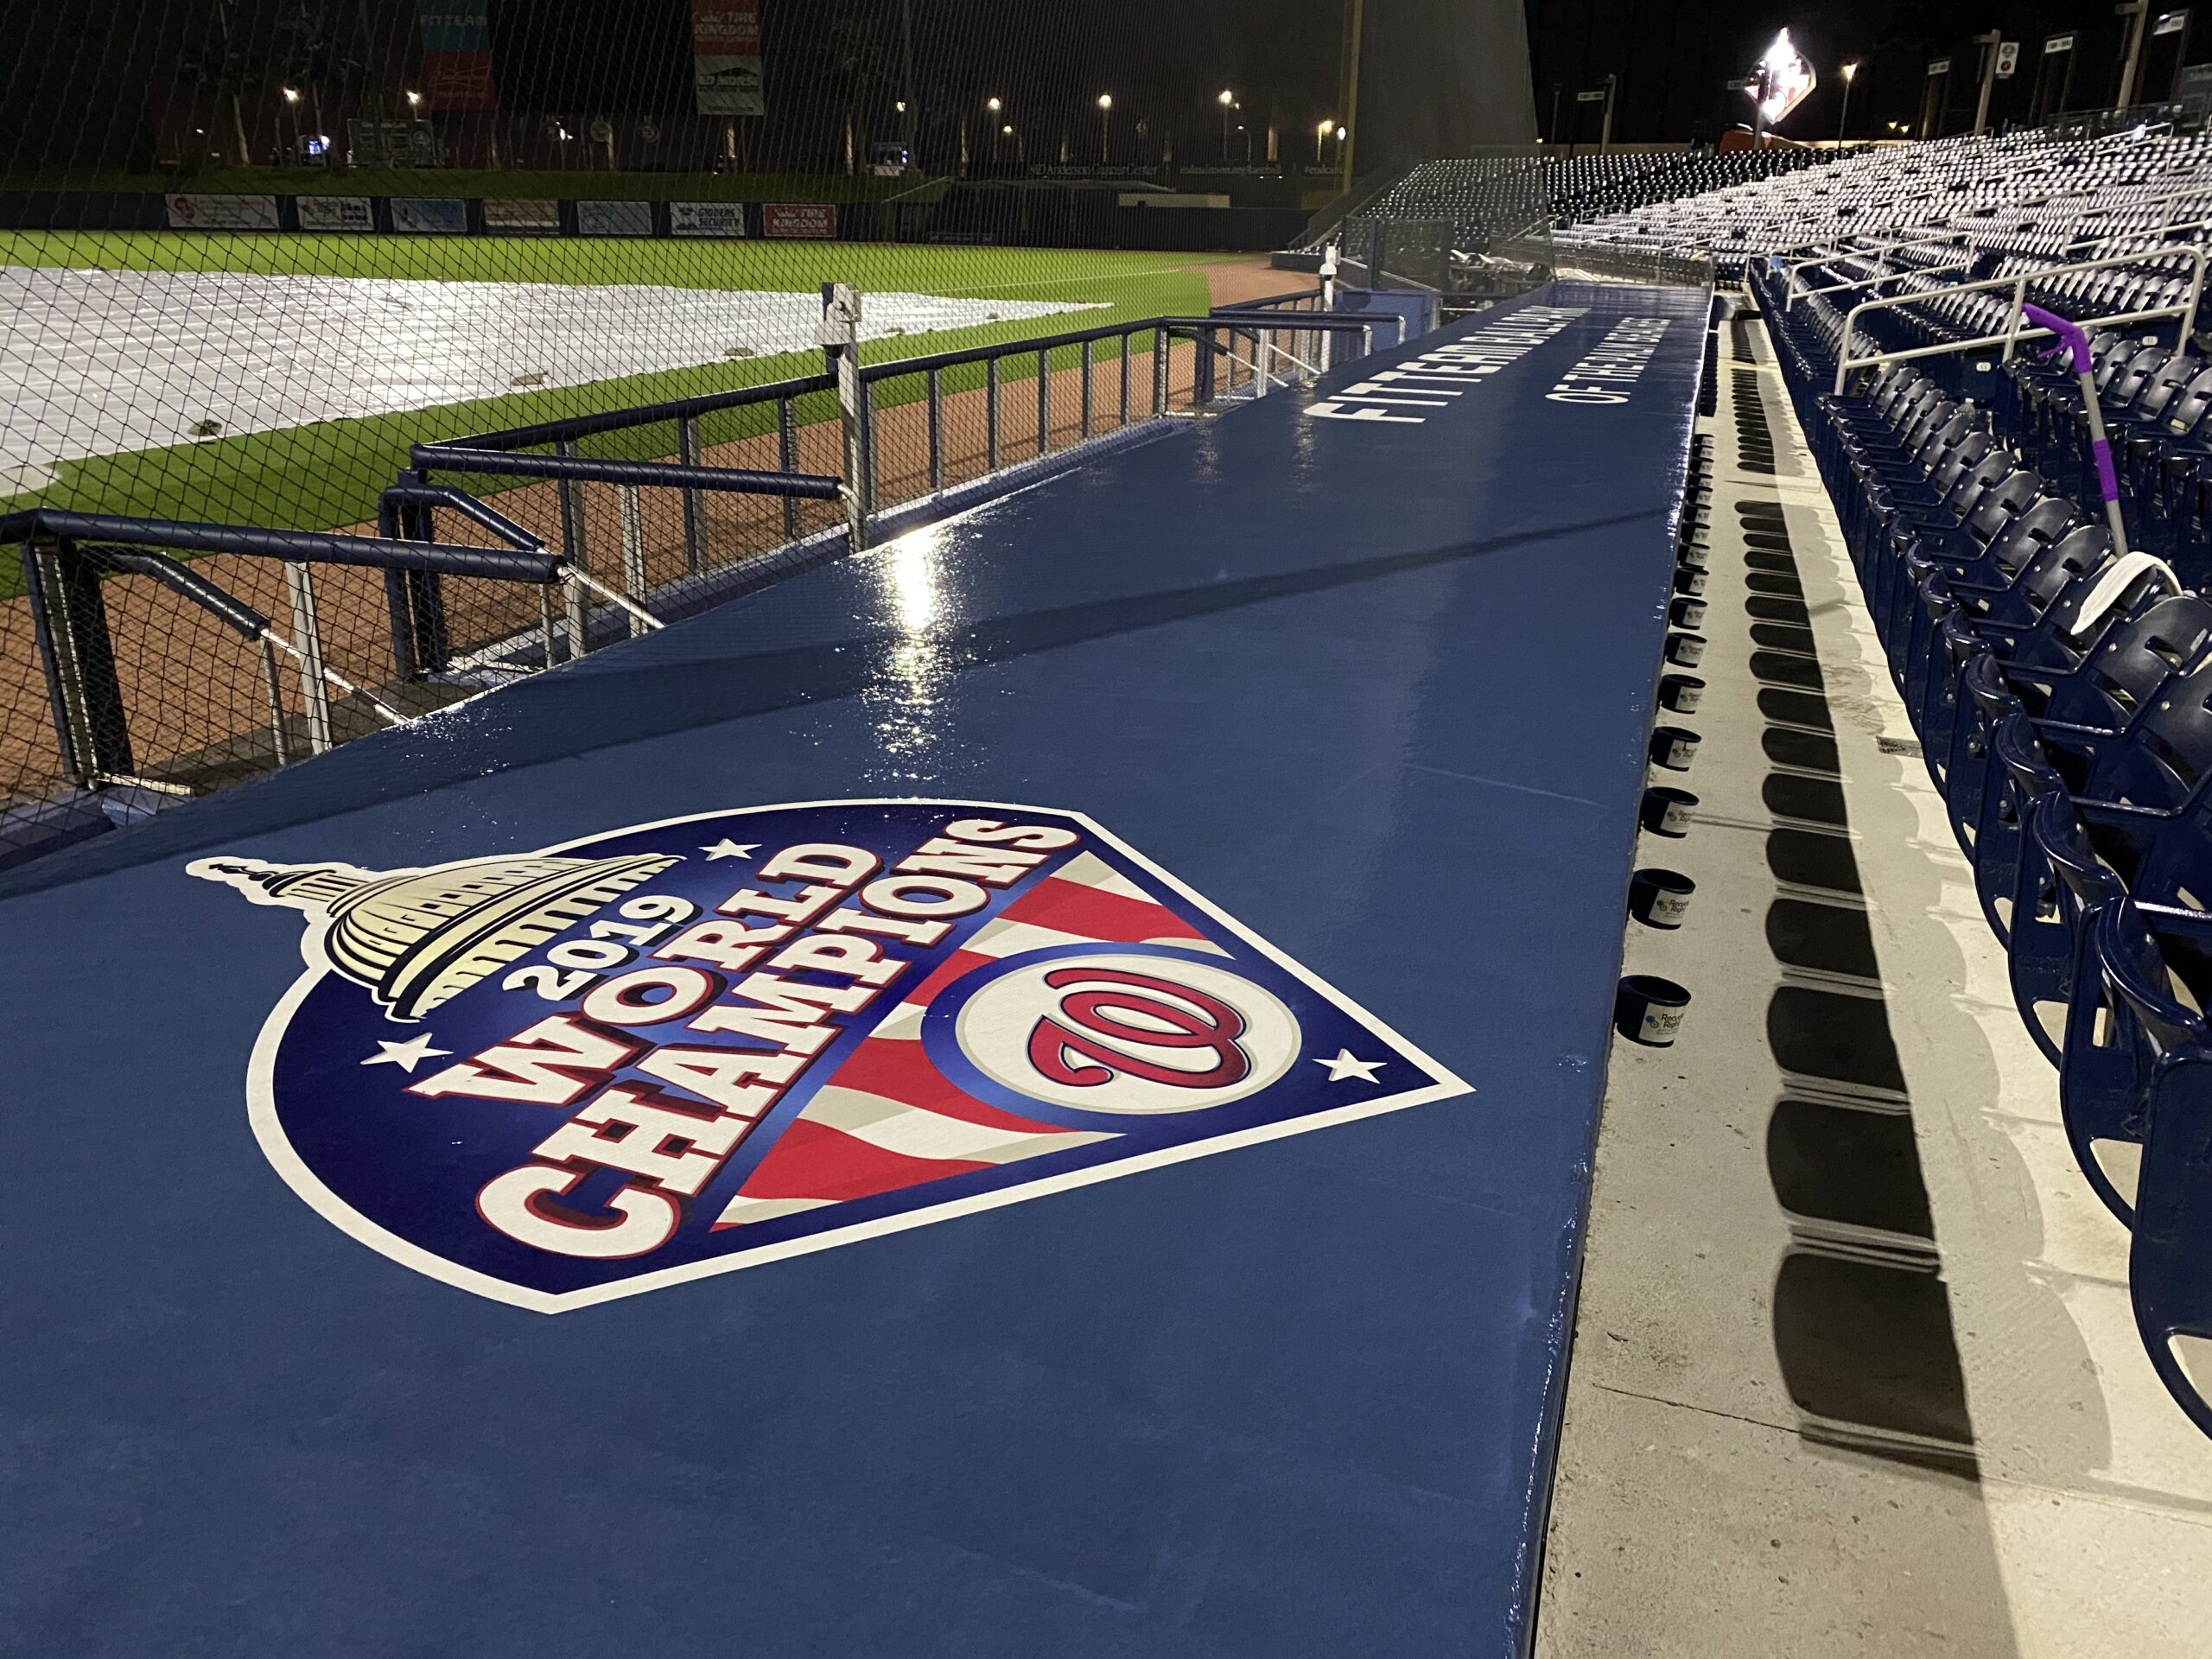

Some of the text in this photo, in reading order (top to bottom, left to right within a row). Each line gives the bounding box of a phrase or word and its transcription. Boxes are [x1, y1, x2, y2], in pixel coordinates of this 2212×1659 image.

[772, 219, 828, 228] KINGDOM
[1303, 305, 1592, 423] FITTEAM BALLPARK
[1562, 361, 1645, 382] THE
[1583, 341, 1657, 363] PALM
[1545, 384, 1631, 404] OF
[403, 843, 881, 1106] WORLD
[502, 895, 698, 1001] 2019
[475, 819, 1080, 1260] CHAMPIONS
